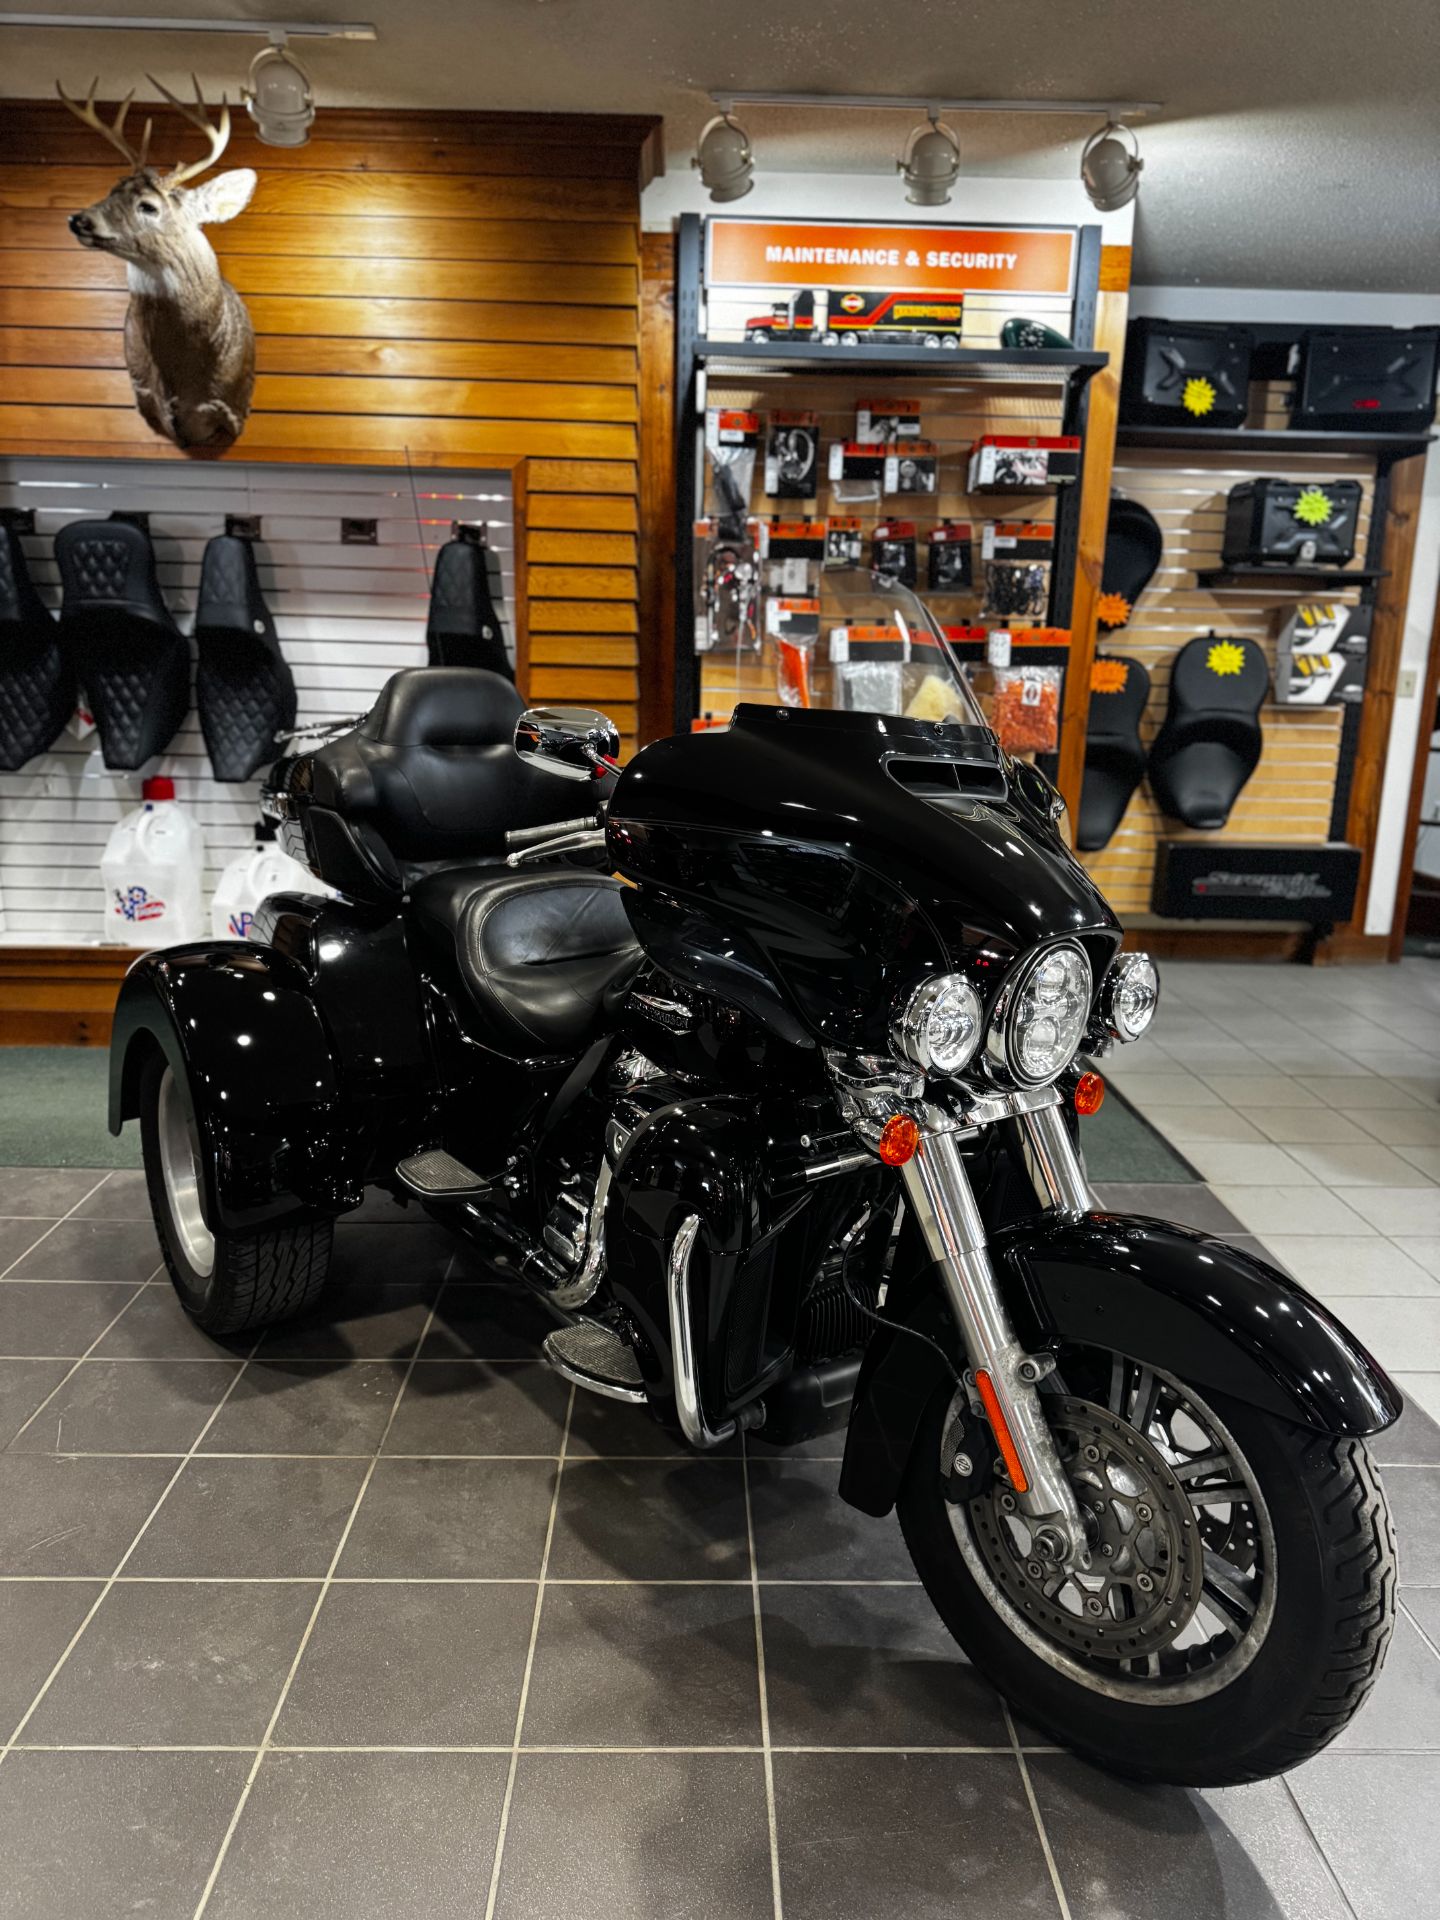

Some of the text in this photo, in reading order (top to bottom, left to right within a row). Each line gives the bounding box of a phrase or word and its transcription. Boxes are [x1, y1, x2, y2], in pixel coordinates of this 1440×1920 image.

[765, 246, 1018, 270] MAINTENANCE & SECURITY
